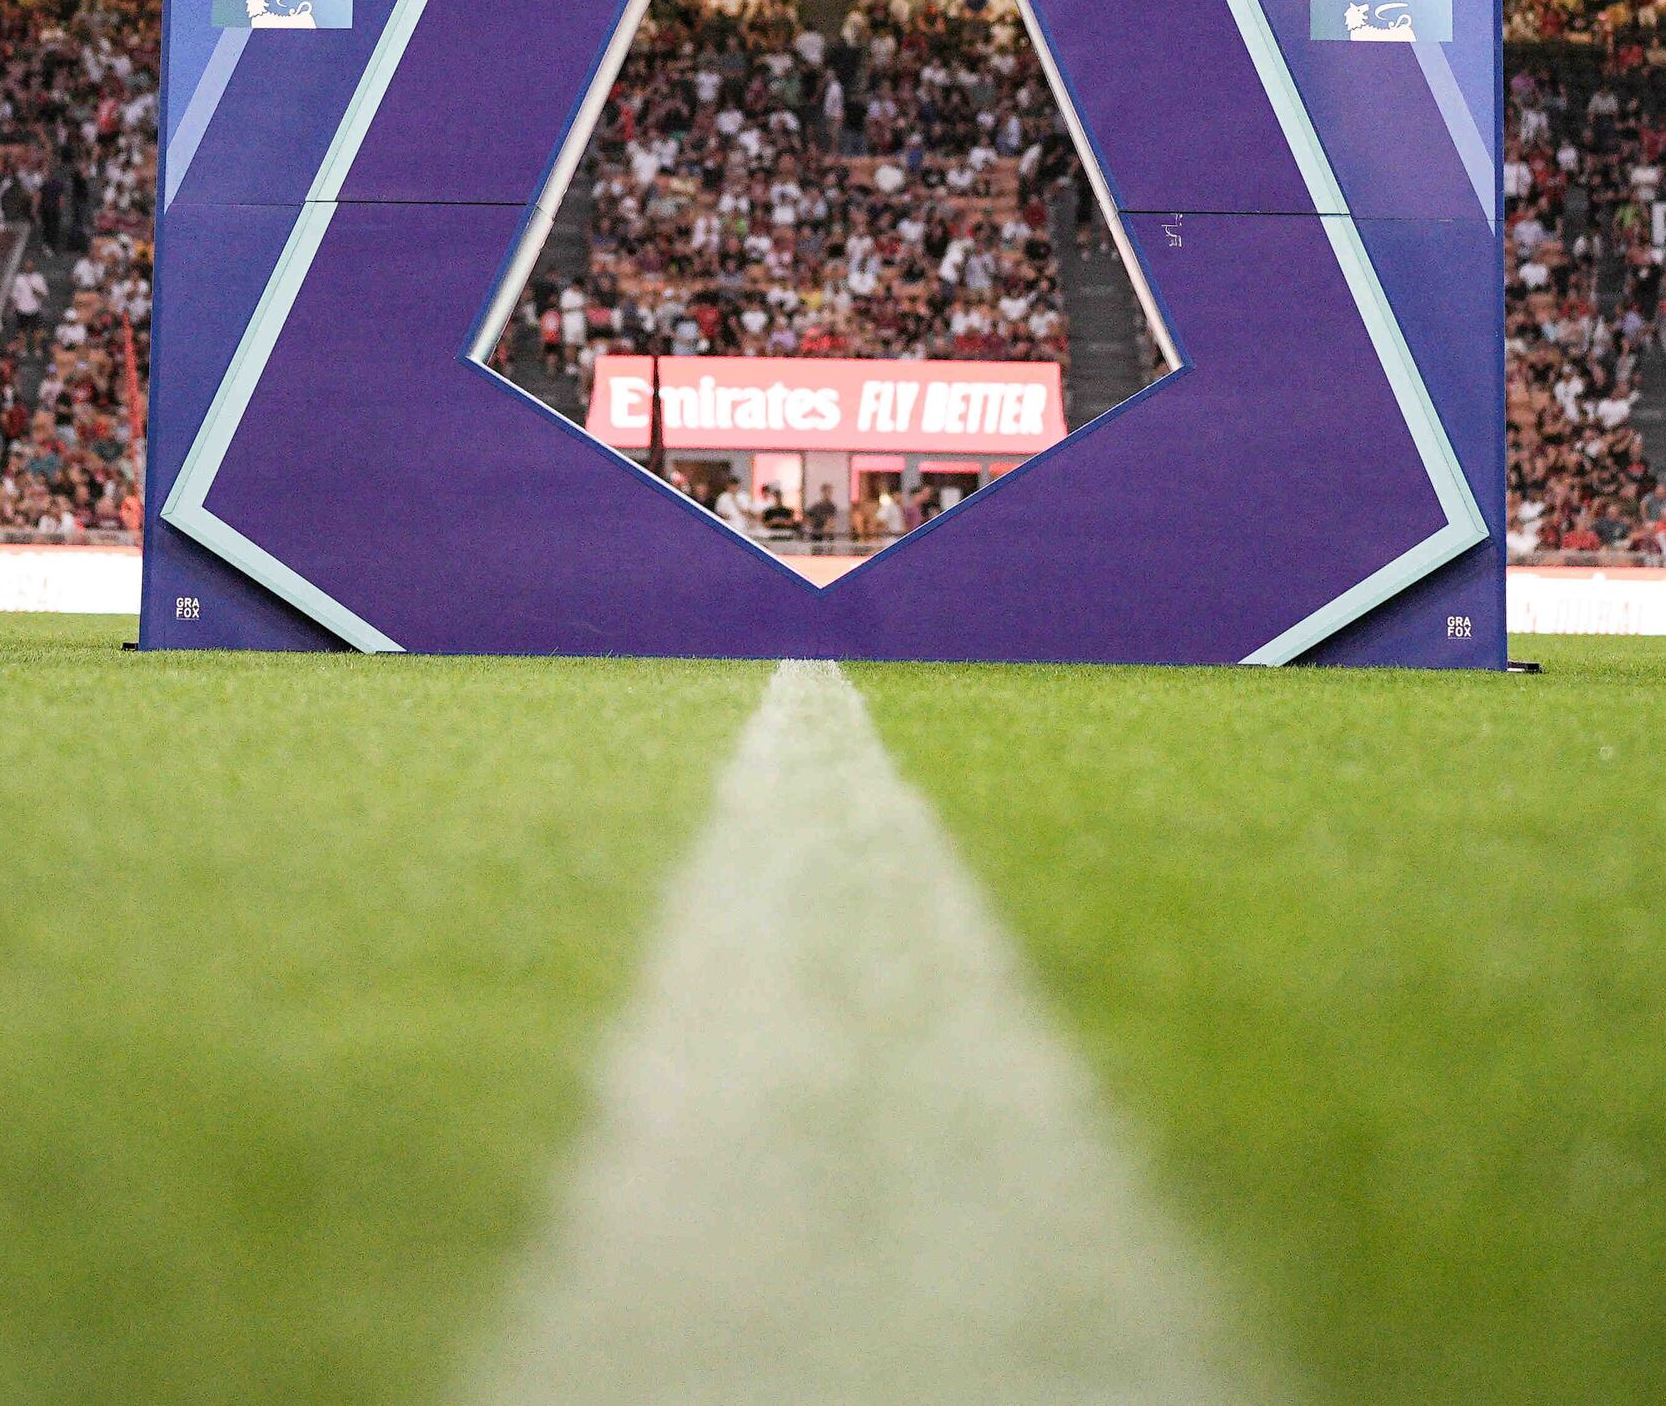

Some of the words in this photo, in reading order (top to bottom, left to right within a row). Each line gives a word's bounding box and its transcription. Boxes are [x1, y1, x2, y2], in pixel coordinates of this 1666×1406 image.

[609, 376, 841, 432] Emirates
[857, 381, 920, 433] FLY
[921, 382, 1047, 435] BETTER
[176, 597, 200, 608] GRA
[176, 608, 200, 618] FOX
[1447, 616, 1471, 627] GRA
[1447, 627, 1472, 637] FOX
